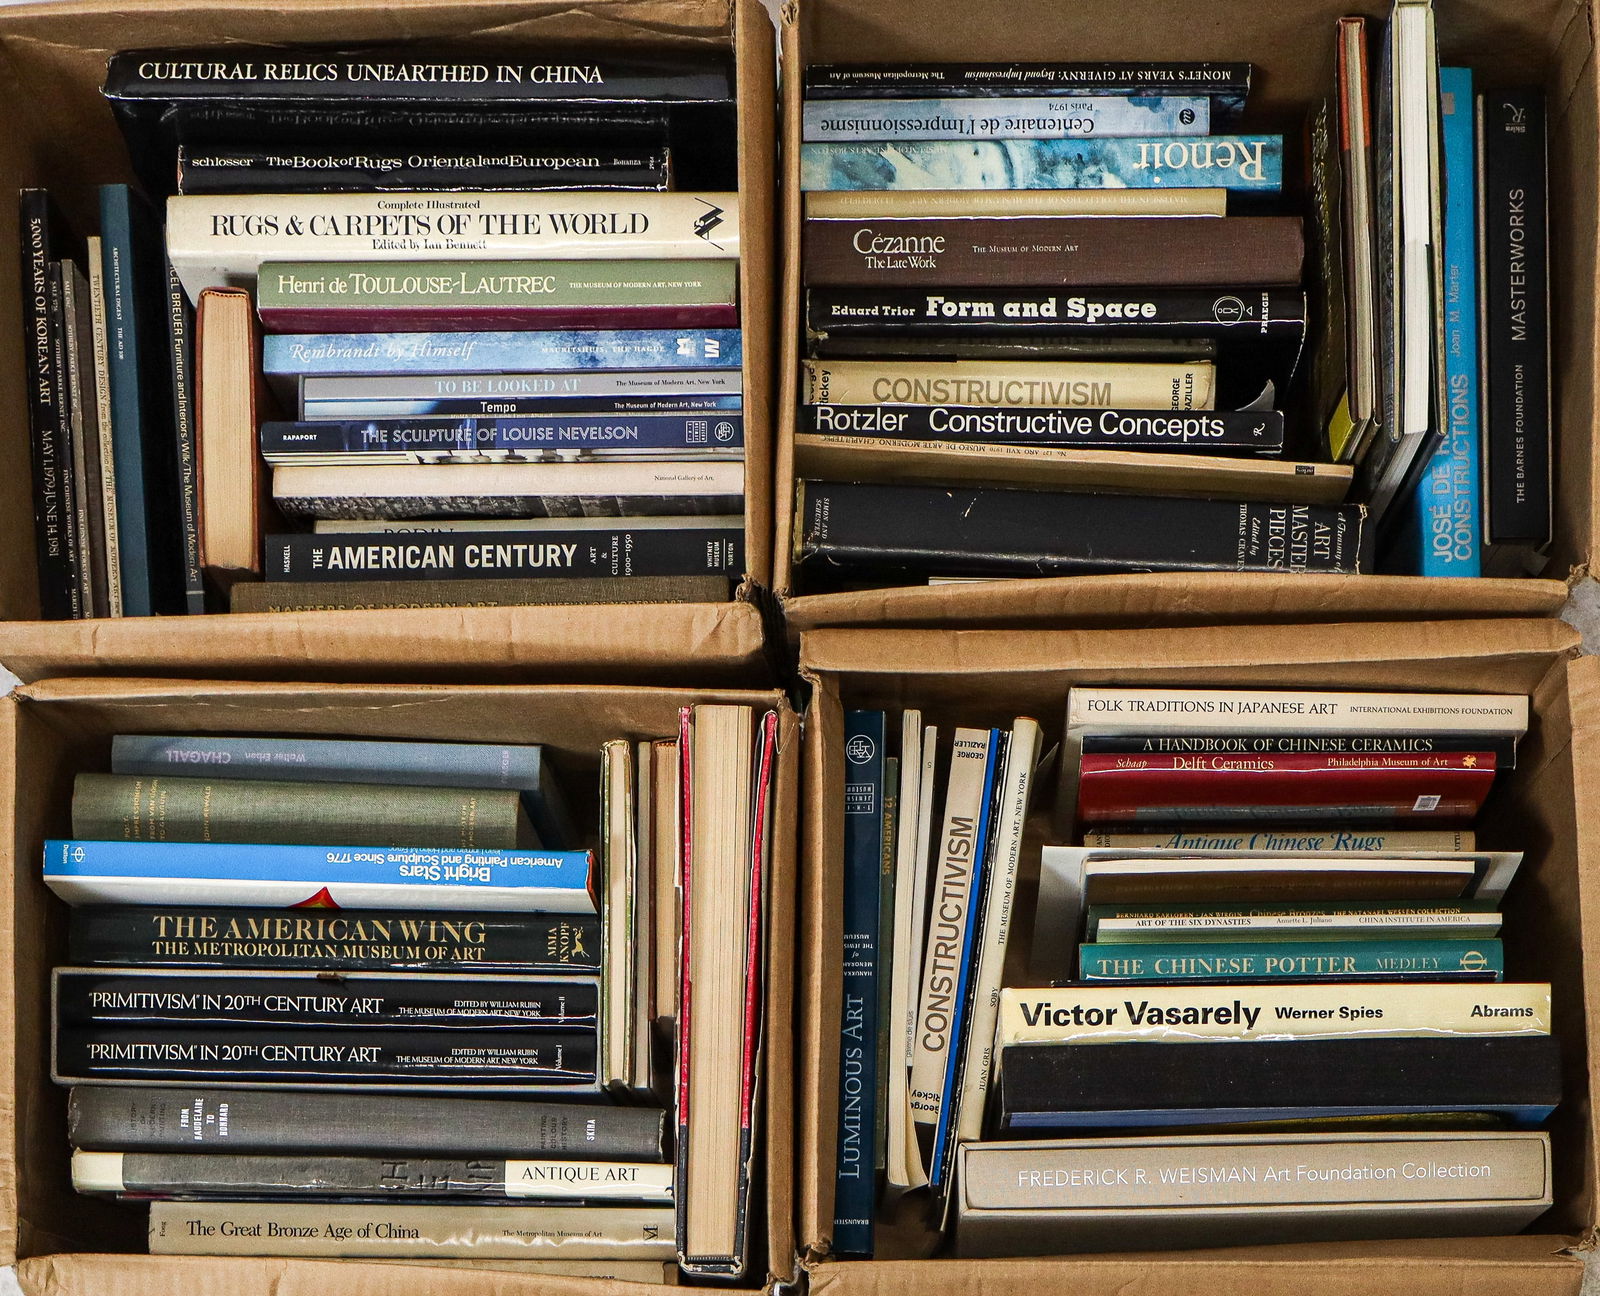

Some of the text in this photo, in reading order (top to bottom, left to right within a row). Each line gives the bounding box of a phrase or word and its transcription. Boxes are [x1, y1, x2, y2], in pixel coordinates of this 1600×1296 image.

[138, 62, 604, 84] CULTURAL RELICS UNEARTHED IN CHINA
[965, 68, 1231, 81] MONET'S YEARS AT GIVERNY: Beyond Impressionism
[1049, 103, 1094, 111] Paris 1974
[1132, 141, 1267, 184] Renoir
[377, 200, 480, 211] Complete Illustrated
[210, 212, 649, 236] RUGS & CARPETS OF THE WORLD
[1509, 189, 1526, 340] MASTERWORKS
[31, 218, 51, 406] 5,000 YEARS OF KOREAN ART
[831, 305, 916, 316] Eduard Trier
[926, 296, 1157, 322] Form and Space
[435, 379, 581, 393] TO BE LOOKED AT
[873, 377, 1113, 406] CONSTRUCTIVISM
[480, 402, 516, 415] Tempo
[361, 425, 638, 443] THE SCULPTURE OF LOUISE NEVELSON
[816, 407, 1225, 442] Rotzler Constructive Concepts
[1515, 365, 1525, 503] THE BARNES FOUNDATION
[1451, 375, 1472, 560] CONSTRUCTIONS
[1313, 521, 1331, 559] ART
[313, 543, 577, 570] THE AMERICAN CENTURY
[1088, 699, 1338, 714] FOLK TRADITIONS IN JAPANESE ART
[1350, 706, 1513, 715] INTERNATIONAL EXHIBITIONS FOUNDATION
[1143, 738, 1433, 752] A HANDBOOK OF CHINESE CERAMICS
[166, 750, 231, 763] CHAGALL
[1116, 757, 1274, 770] Schaap Delft Ceramics
[1328, 758, 1448, 768] Philadelphia Museum of Art
[327, 852, 564, 868] American Painting and Sculpture Since 1776
[998, 772, 1026, 945] THE MUSEUM OF MODERN ART, NEW YORK
[399, 864, 491, 882] Bright Stars
[152, 915, 486, 943] THE AMERICAN WING
[1135, 919, 1152, 927] ART
[1154, 919, 1166, 927] OF
[1204, 918, 1251, 926] DYNASTIES
[923, 817, 974, 1052] CONSTRUCTIVISM
[152, 942, 486, 961] THE METROPOLITAN MUSEUM OF ART
[1097, 956, 1441, 975] THE CHINESE POTTER MEDLEY
[454, 1000, 479, 1008] EDITED
[490, 1001, 519, 1009] WILLIAM
[1471, 1005, 1534, 1018] Abrams
[1020, 1000, 1383, 1030] Victor Vasarely Werner Spies
[979, 1047, 990, 1091] JUAN GRIS
[839, 994, 863, 1178] LUMINOUS ART
[181, 1108, 189, 1128] FROM
[207, 1114, 215, 1124] TO
[586, 1119, 595, 1141] SKIRA
[522, 1167, 639, 1182] ANTIQUE ART
[1018, 1161, 1492, 1187] FREDERICK R. WEISMAN Art Foundation Collection
[186, 1220, 419, 1241] The Great Bronze Age of China
